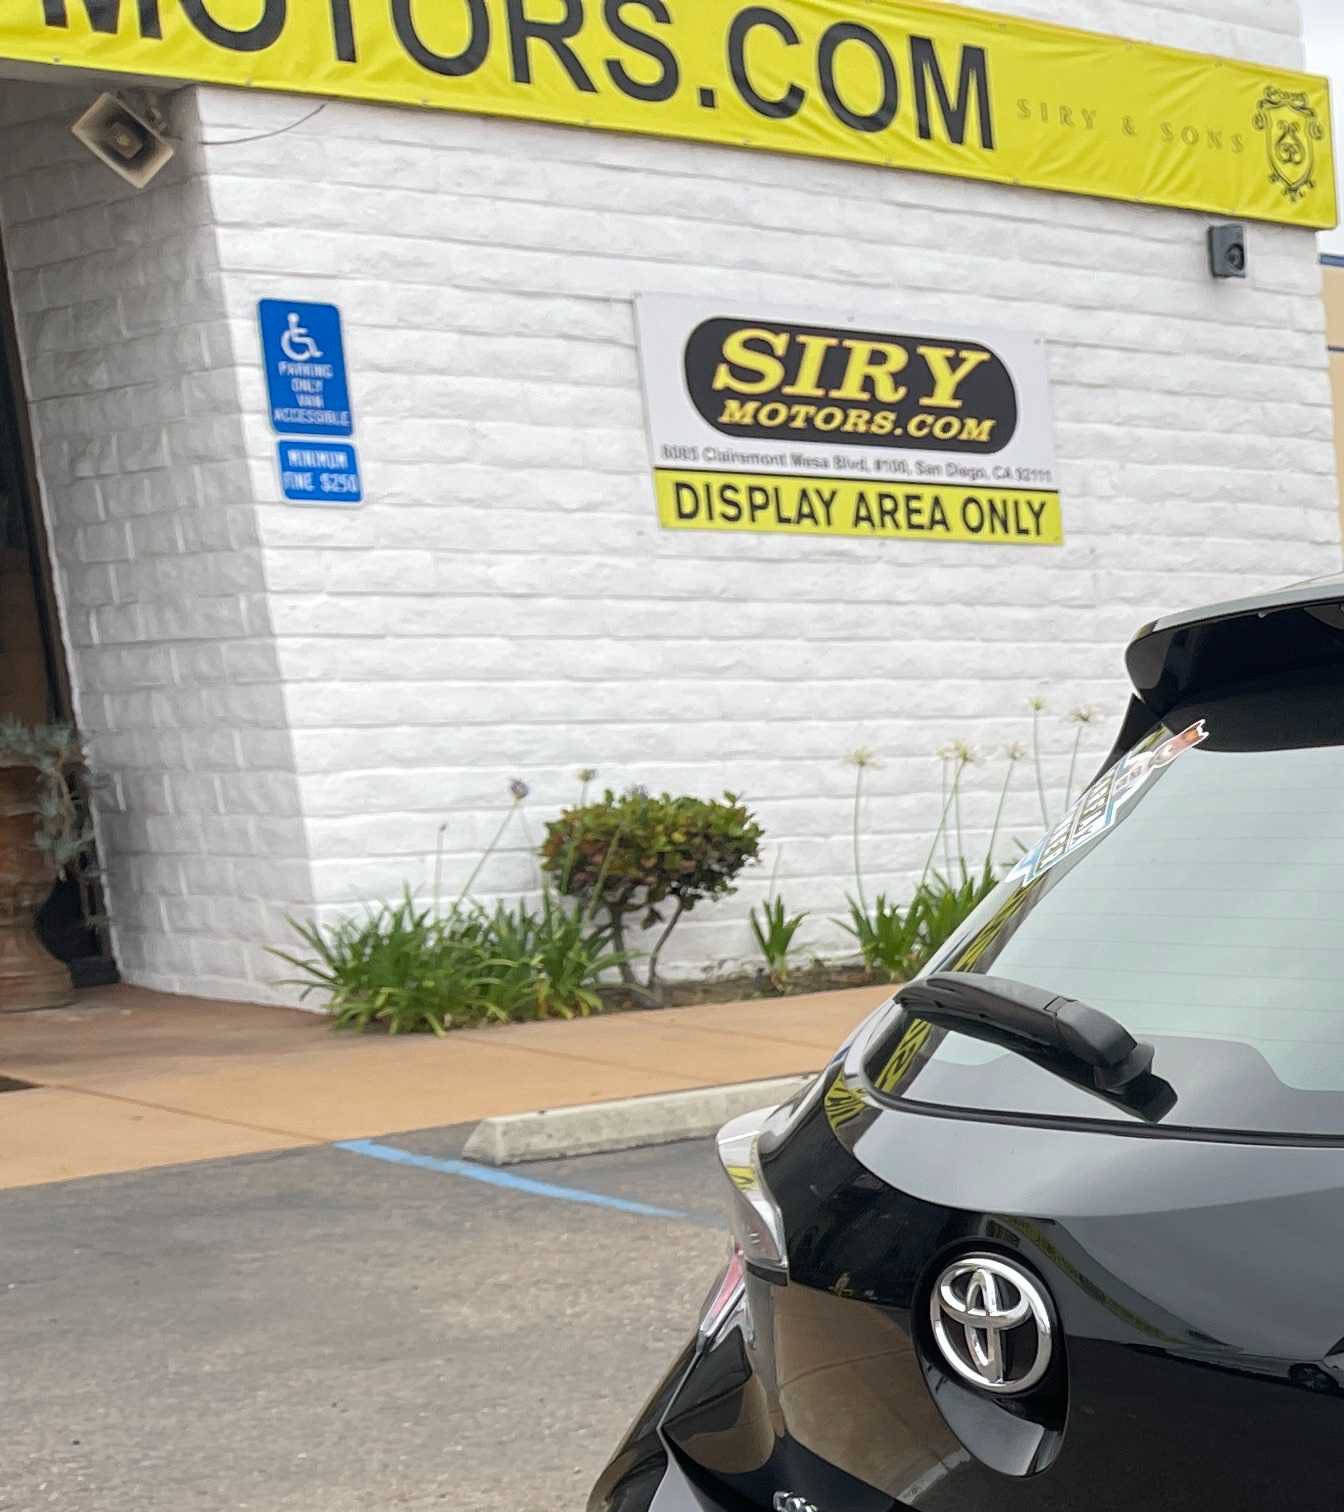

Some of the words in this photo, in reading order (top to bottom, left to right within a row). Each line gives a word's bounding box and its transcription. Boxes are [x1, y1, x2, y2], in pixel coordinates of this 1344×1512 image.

[1017, 98, 1095, 129] SIRY
[1160, 121, 1245, 154] SONS
[712, 327, 991, 408] SIRY
[718, 399, 997, 442] MOTORS.COM
[674, 481, 838, 526] DISPLAY
[853, 491, 951, 531] AREA
[962, 496, 1046, 536] ONLY
